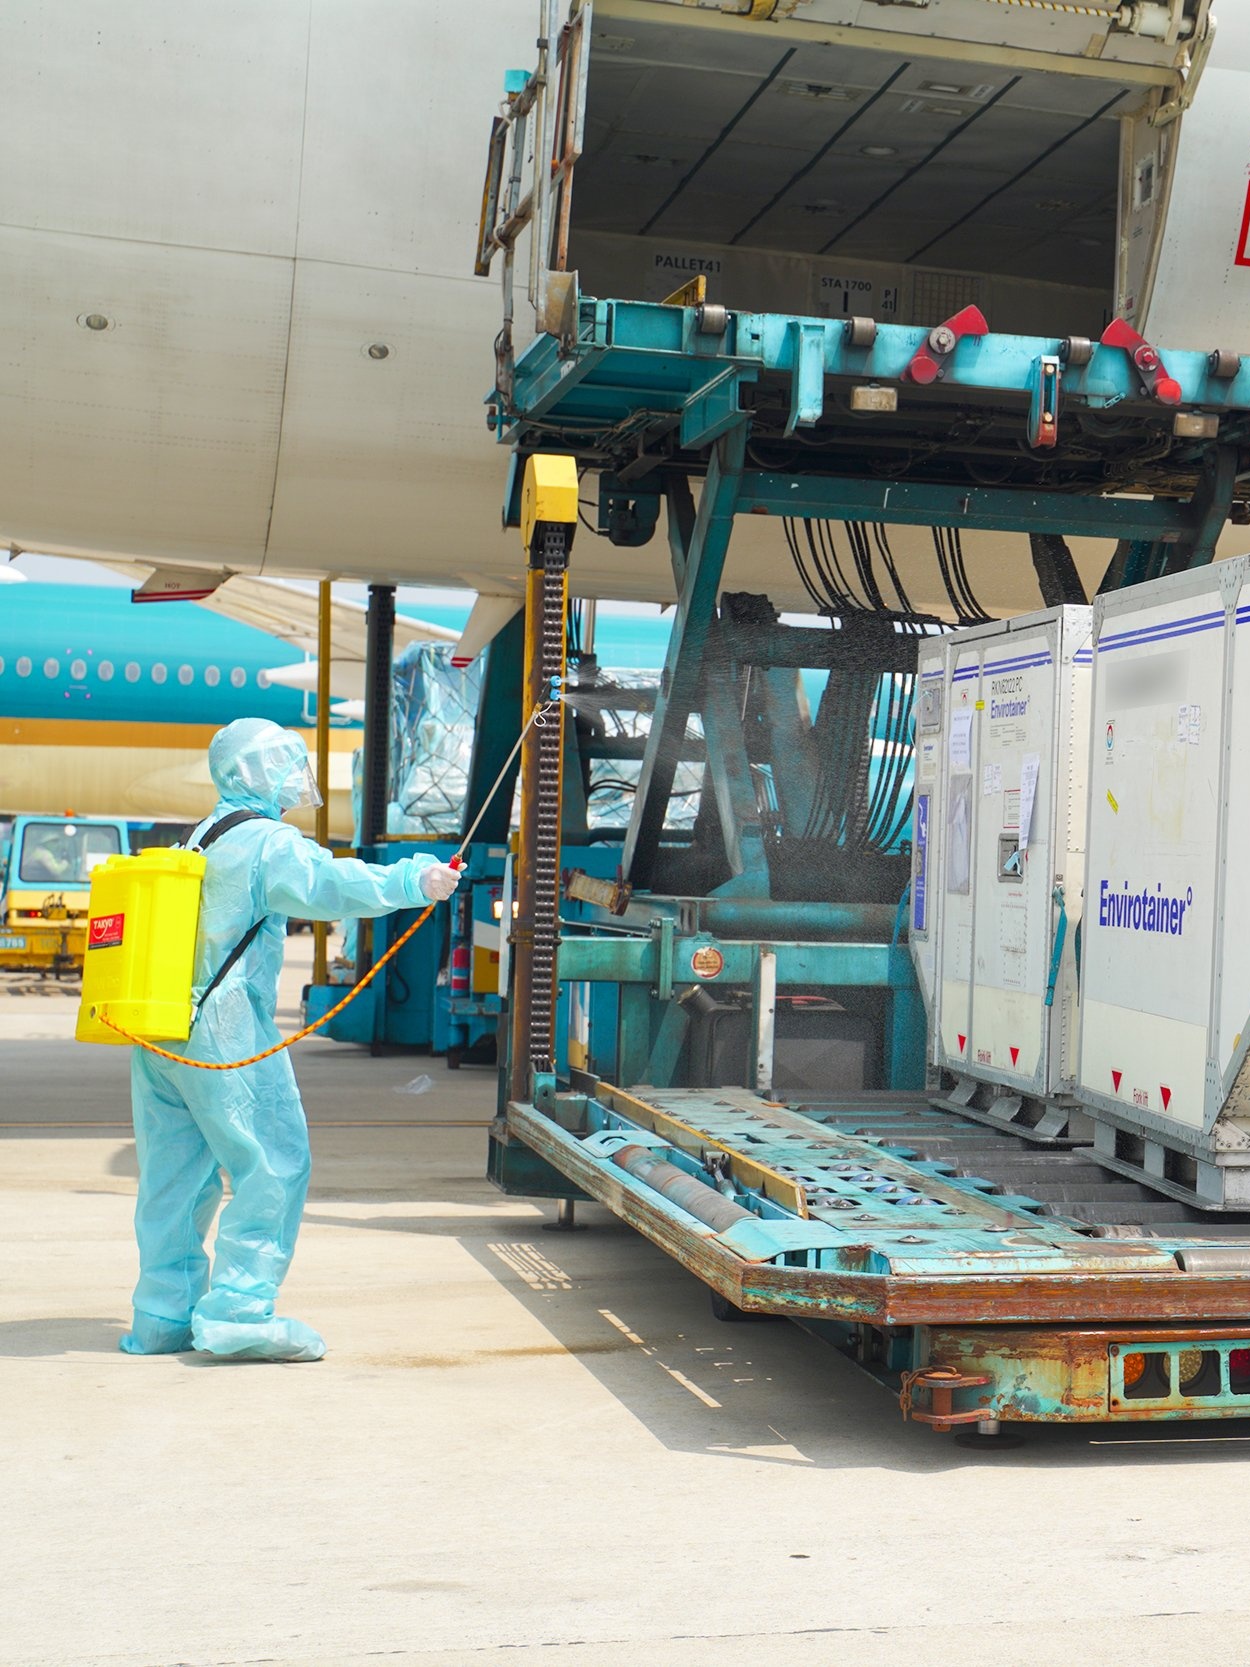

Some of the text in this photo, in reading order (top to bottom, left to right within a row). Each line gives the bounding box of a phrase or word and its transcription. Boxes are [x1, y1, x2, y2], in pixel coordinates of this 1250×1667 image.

[655, 254, 722, 273] PALLET41
[821, 277, 872, 292] STA 1700
